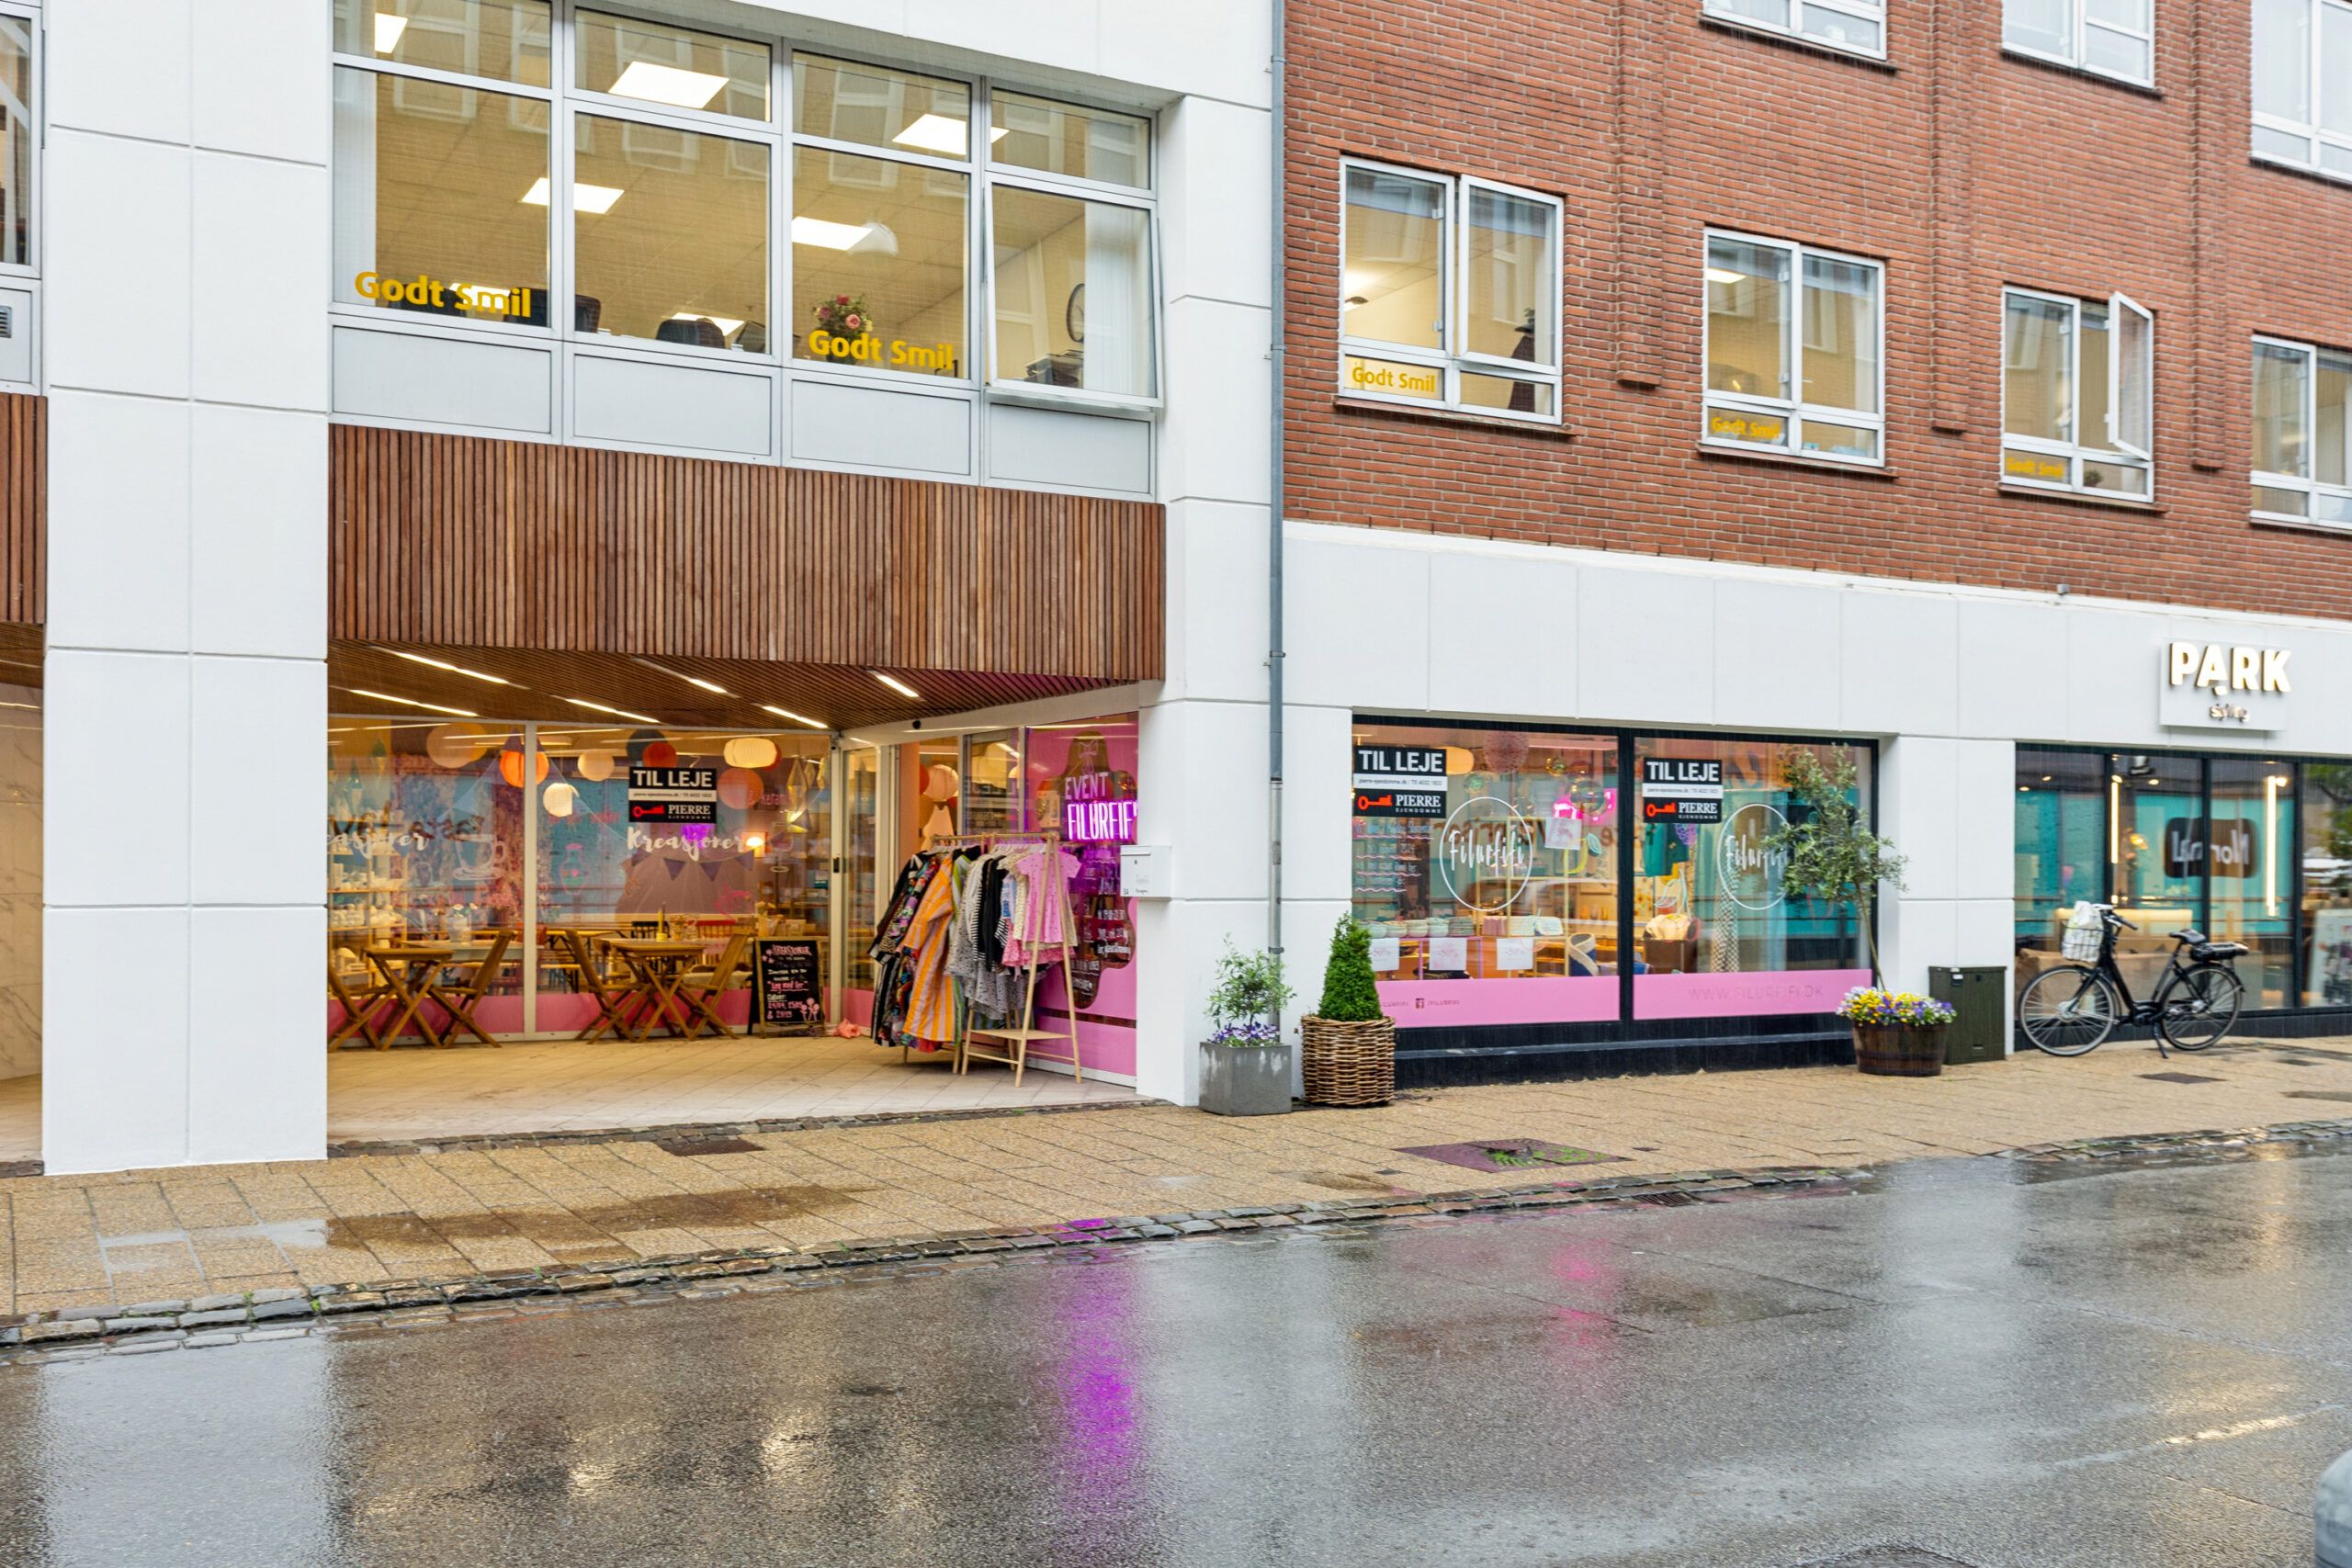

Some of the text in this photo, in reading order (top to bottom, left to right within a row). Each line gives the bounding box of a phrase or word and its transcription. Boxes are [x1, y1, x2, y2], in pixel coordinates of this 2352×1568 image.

[355, 271, 531, 318] Godt Smil
[808, 329, 954, 370] Godt Smil
[1352, 367, 1435, 392] Godt Smil
[2170, 641, 2291, 693] PARK
[1358, 750, 1442, 773] TIL LEJE
[1646, 761, 1720, 782] TIL LEJE
[633, 770, 713, 788] TIL LEJE
[1065, 772, 1109, 800] EVENT
[668, 804, 711, 815] PIERRE
[1396, 794, 1442, 807] PIERRE
[1679, 802, 1718, 814] PIERRE
[1448, 829, 1525, 877] Filurfifi
